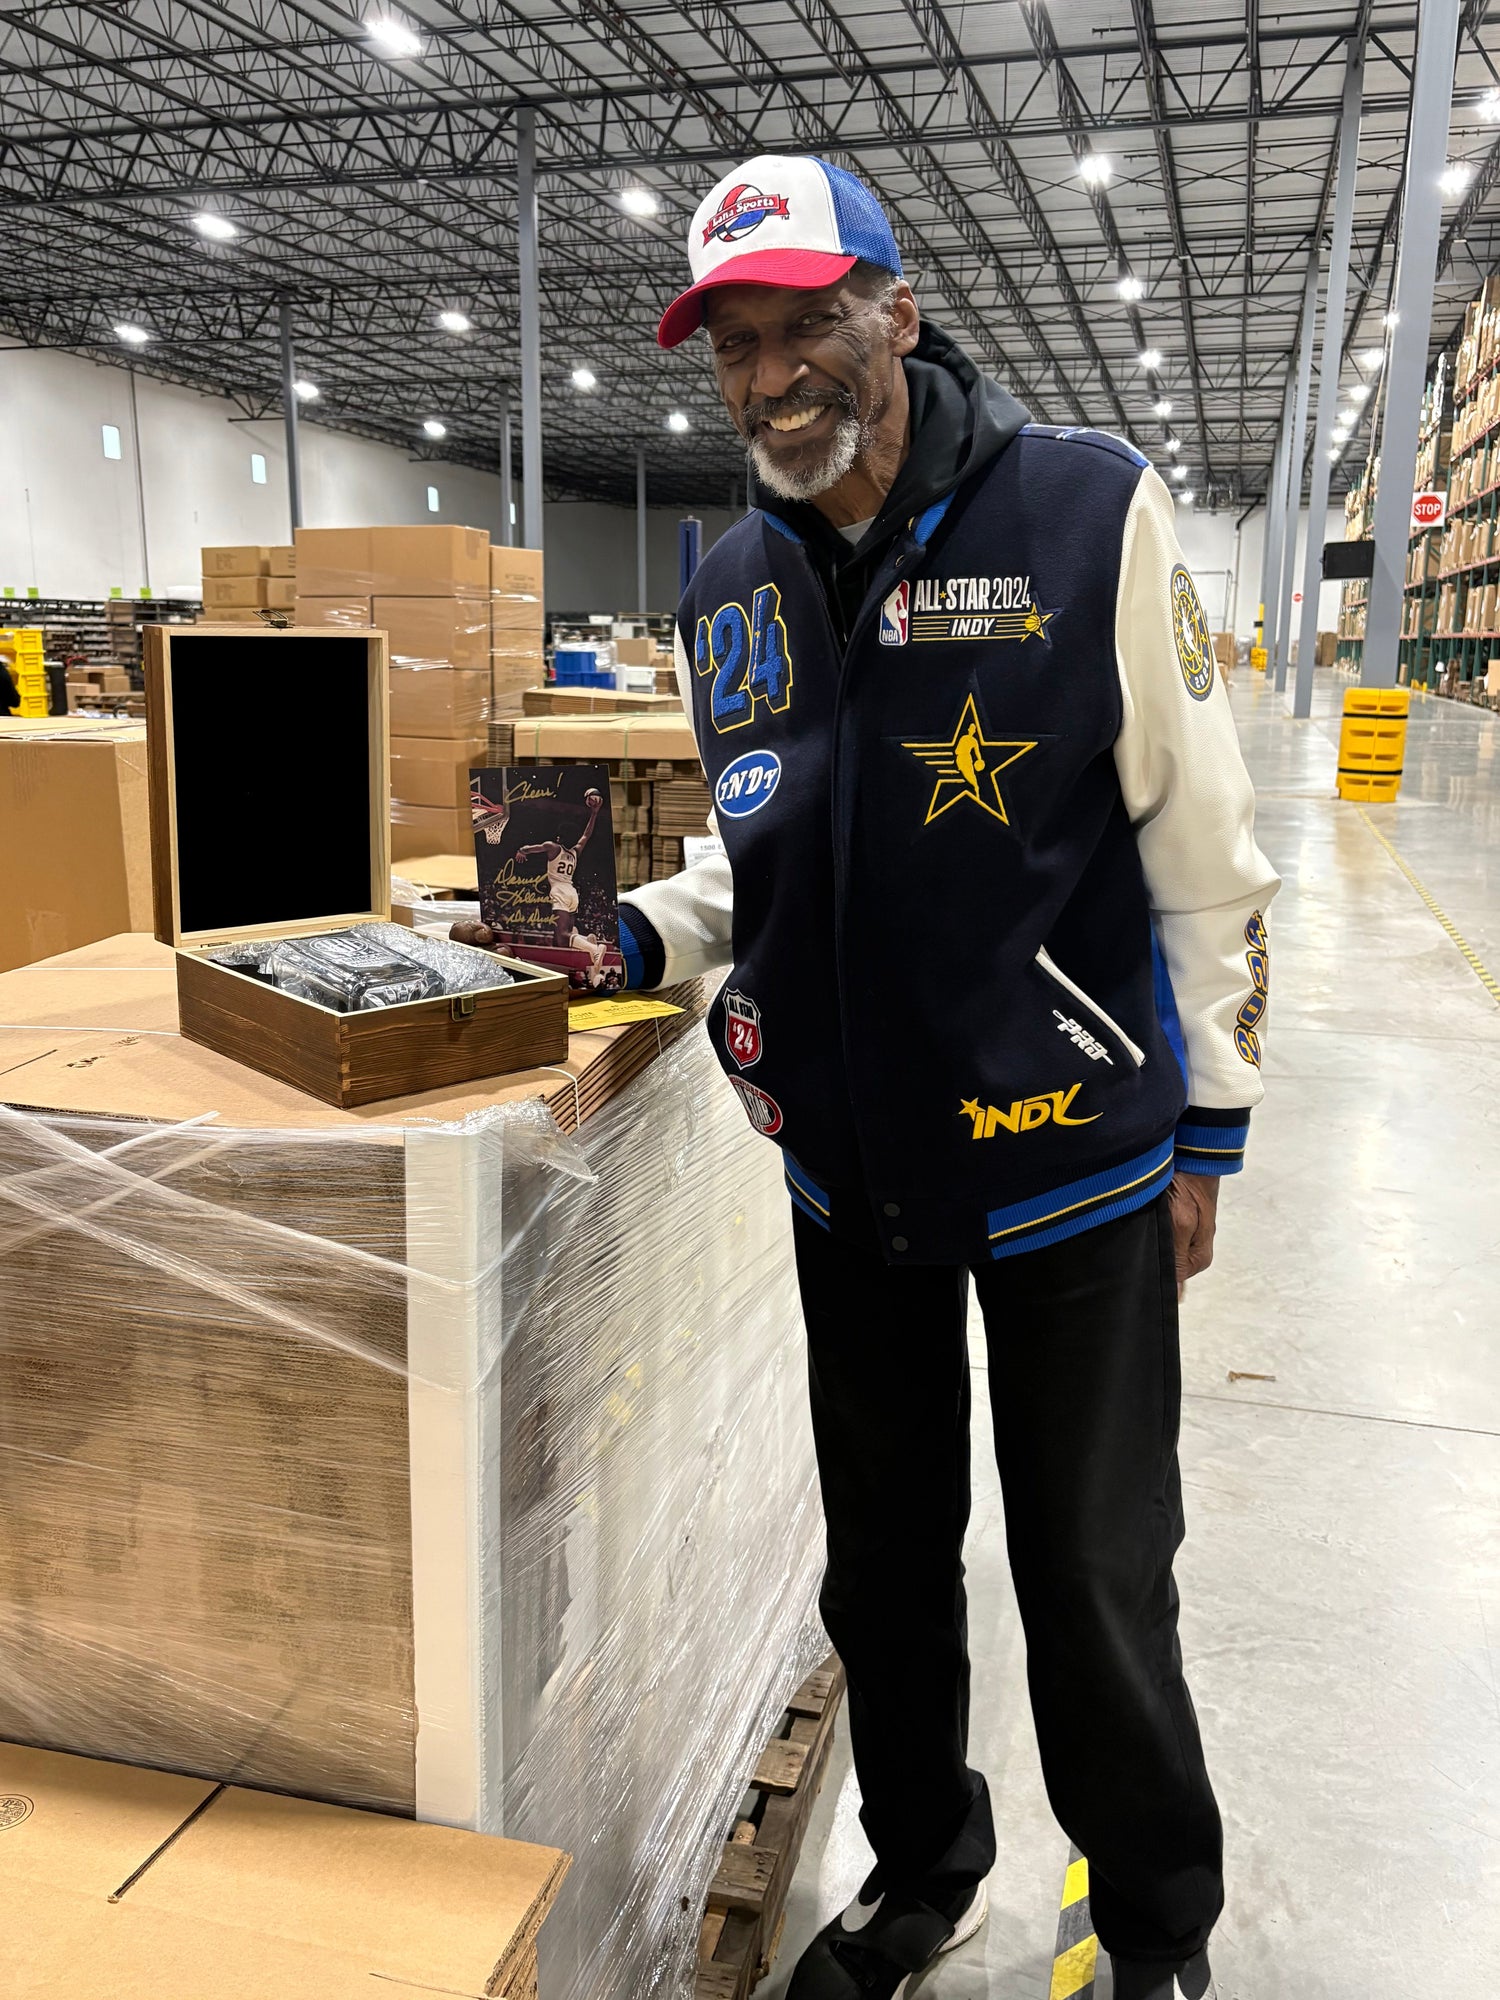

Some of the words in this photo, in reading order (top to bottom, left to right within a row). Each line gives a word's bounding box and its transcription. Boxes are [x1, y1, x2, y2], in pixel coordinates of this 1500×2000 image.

[736, 198, 775, 213] Sports
[1414, 503, 1441, 516] STOP
[913, 579, 942, 612] ALL
[946, 577, 990, 611] STAR
[992, 575, 1032, 609] 2024
[882, 629, 898, 642] NBA
[951, 617, 996, 637] INDY
[505, 772, 564, 803] Cheers!
[720, 766, 780, 802] INDY
[557, 861, 574, 876] 20
[966, 1083, 1103, 1140] INDY
